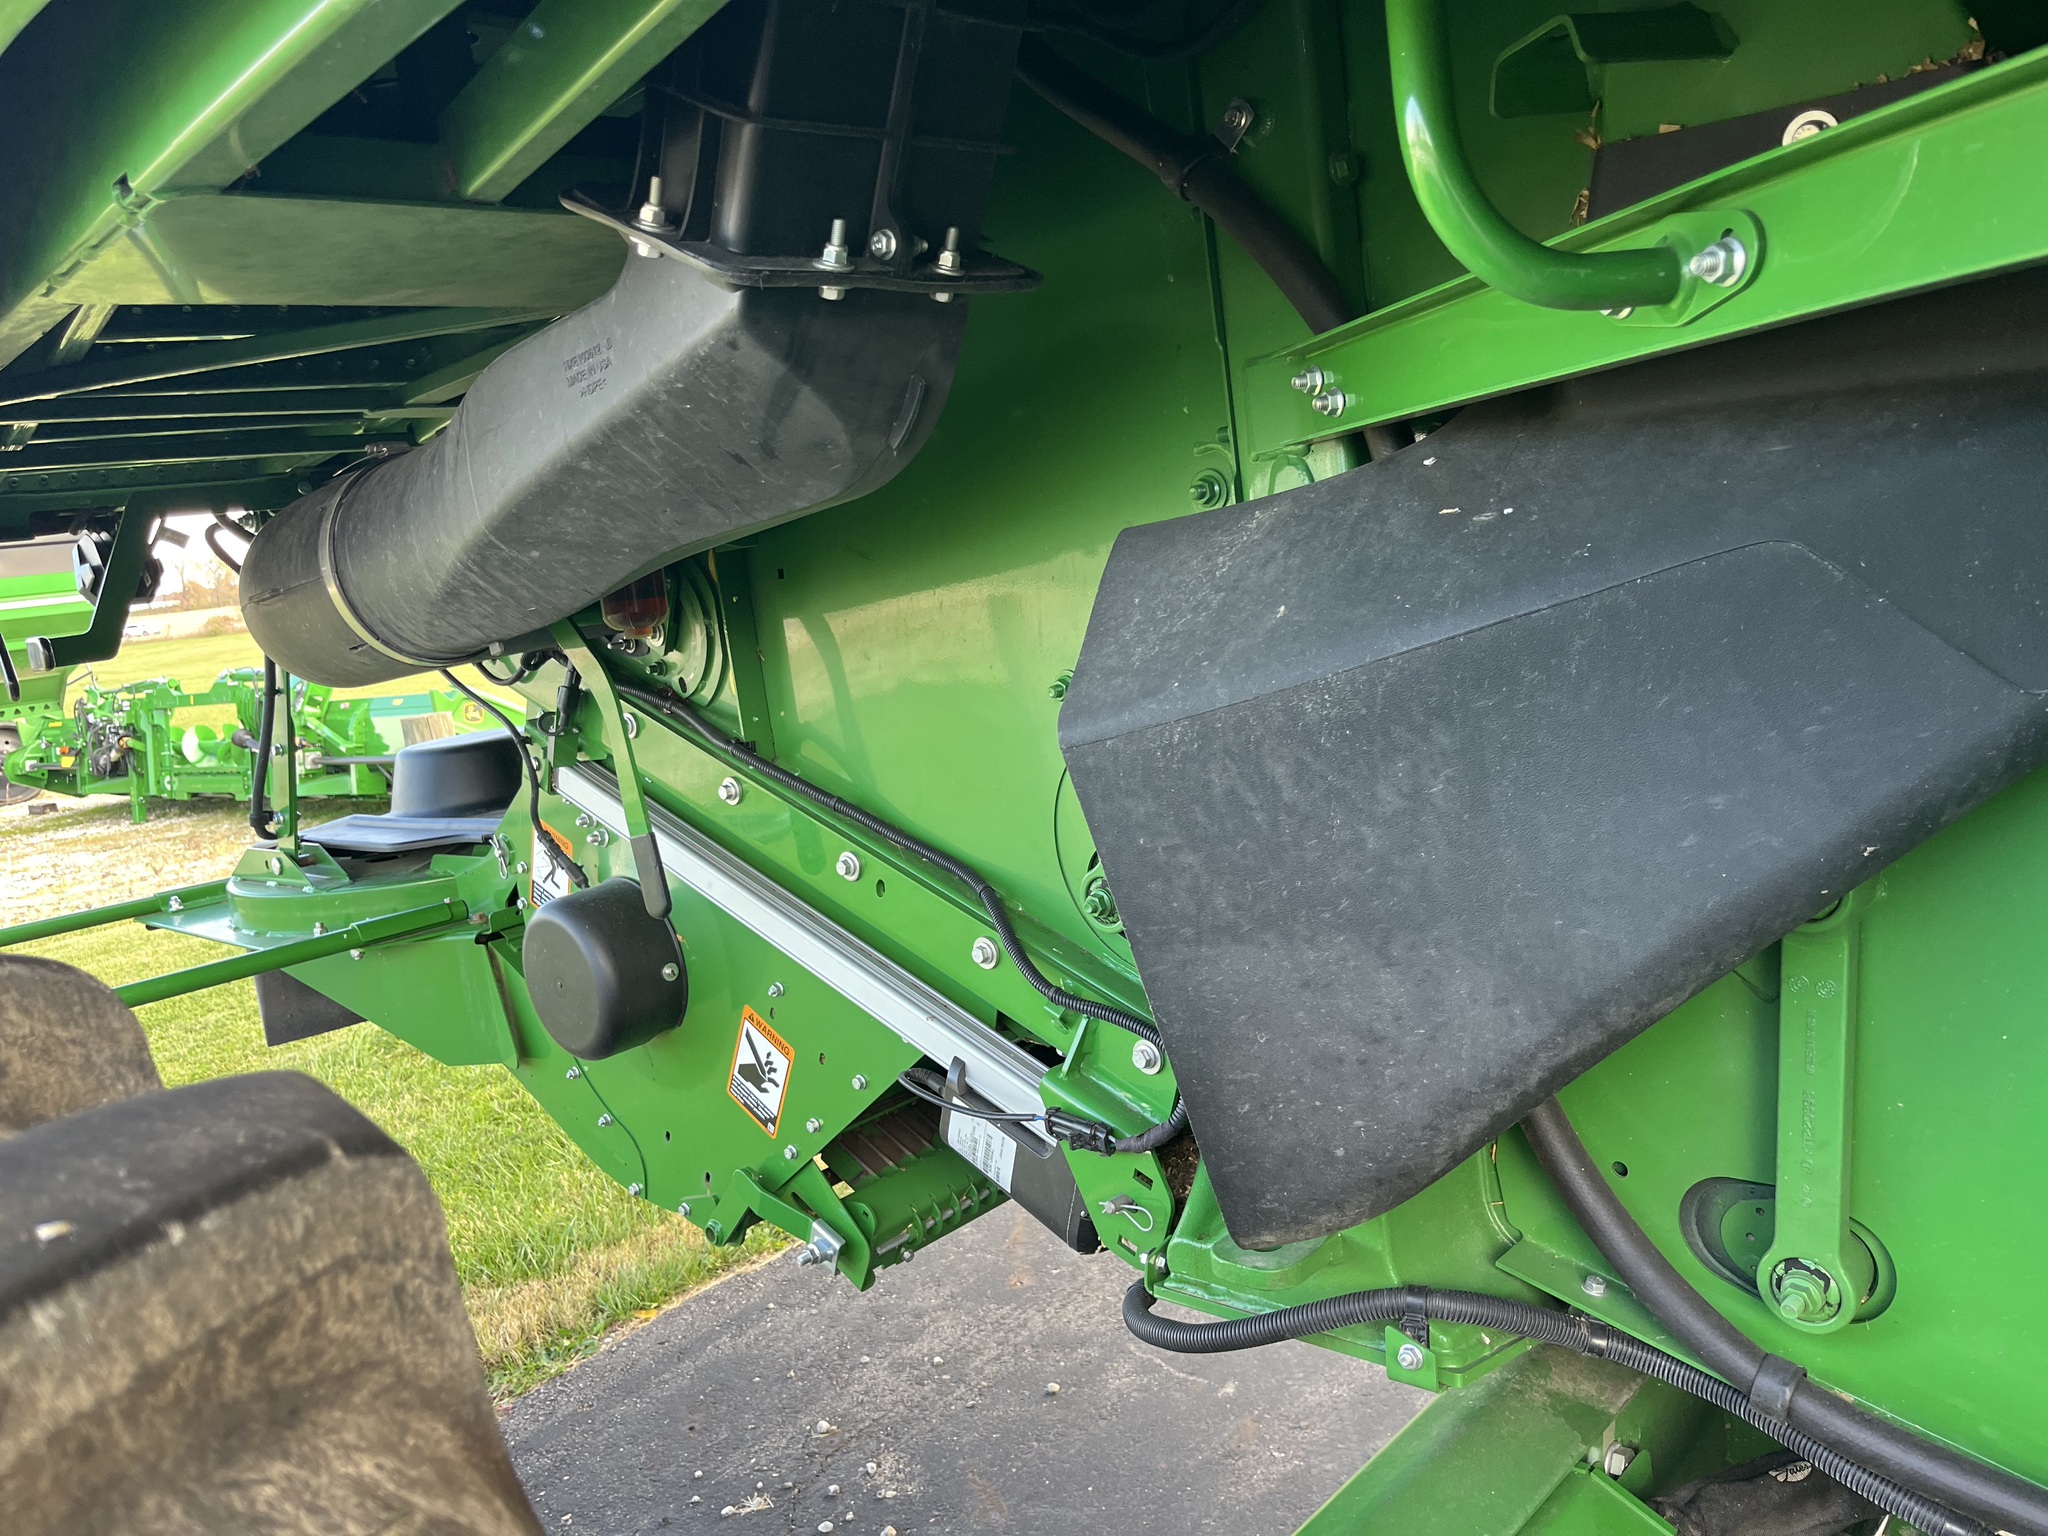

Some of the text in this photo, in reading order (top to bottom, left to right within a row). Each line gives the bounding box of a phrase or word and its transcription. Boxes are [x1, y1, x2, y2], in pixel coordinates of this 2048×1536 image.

[566, 356, 613, 388] MADE IN USA
[755, 1017, 791, 1057] WARNING
